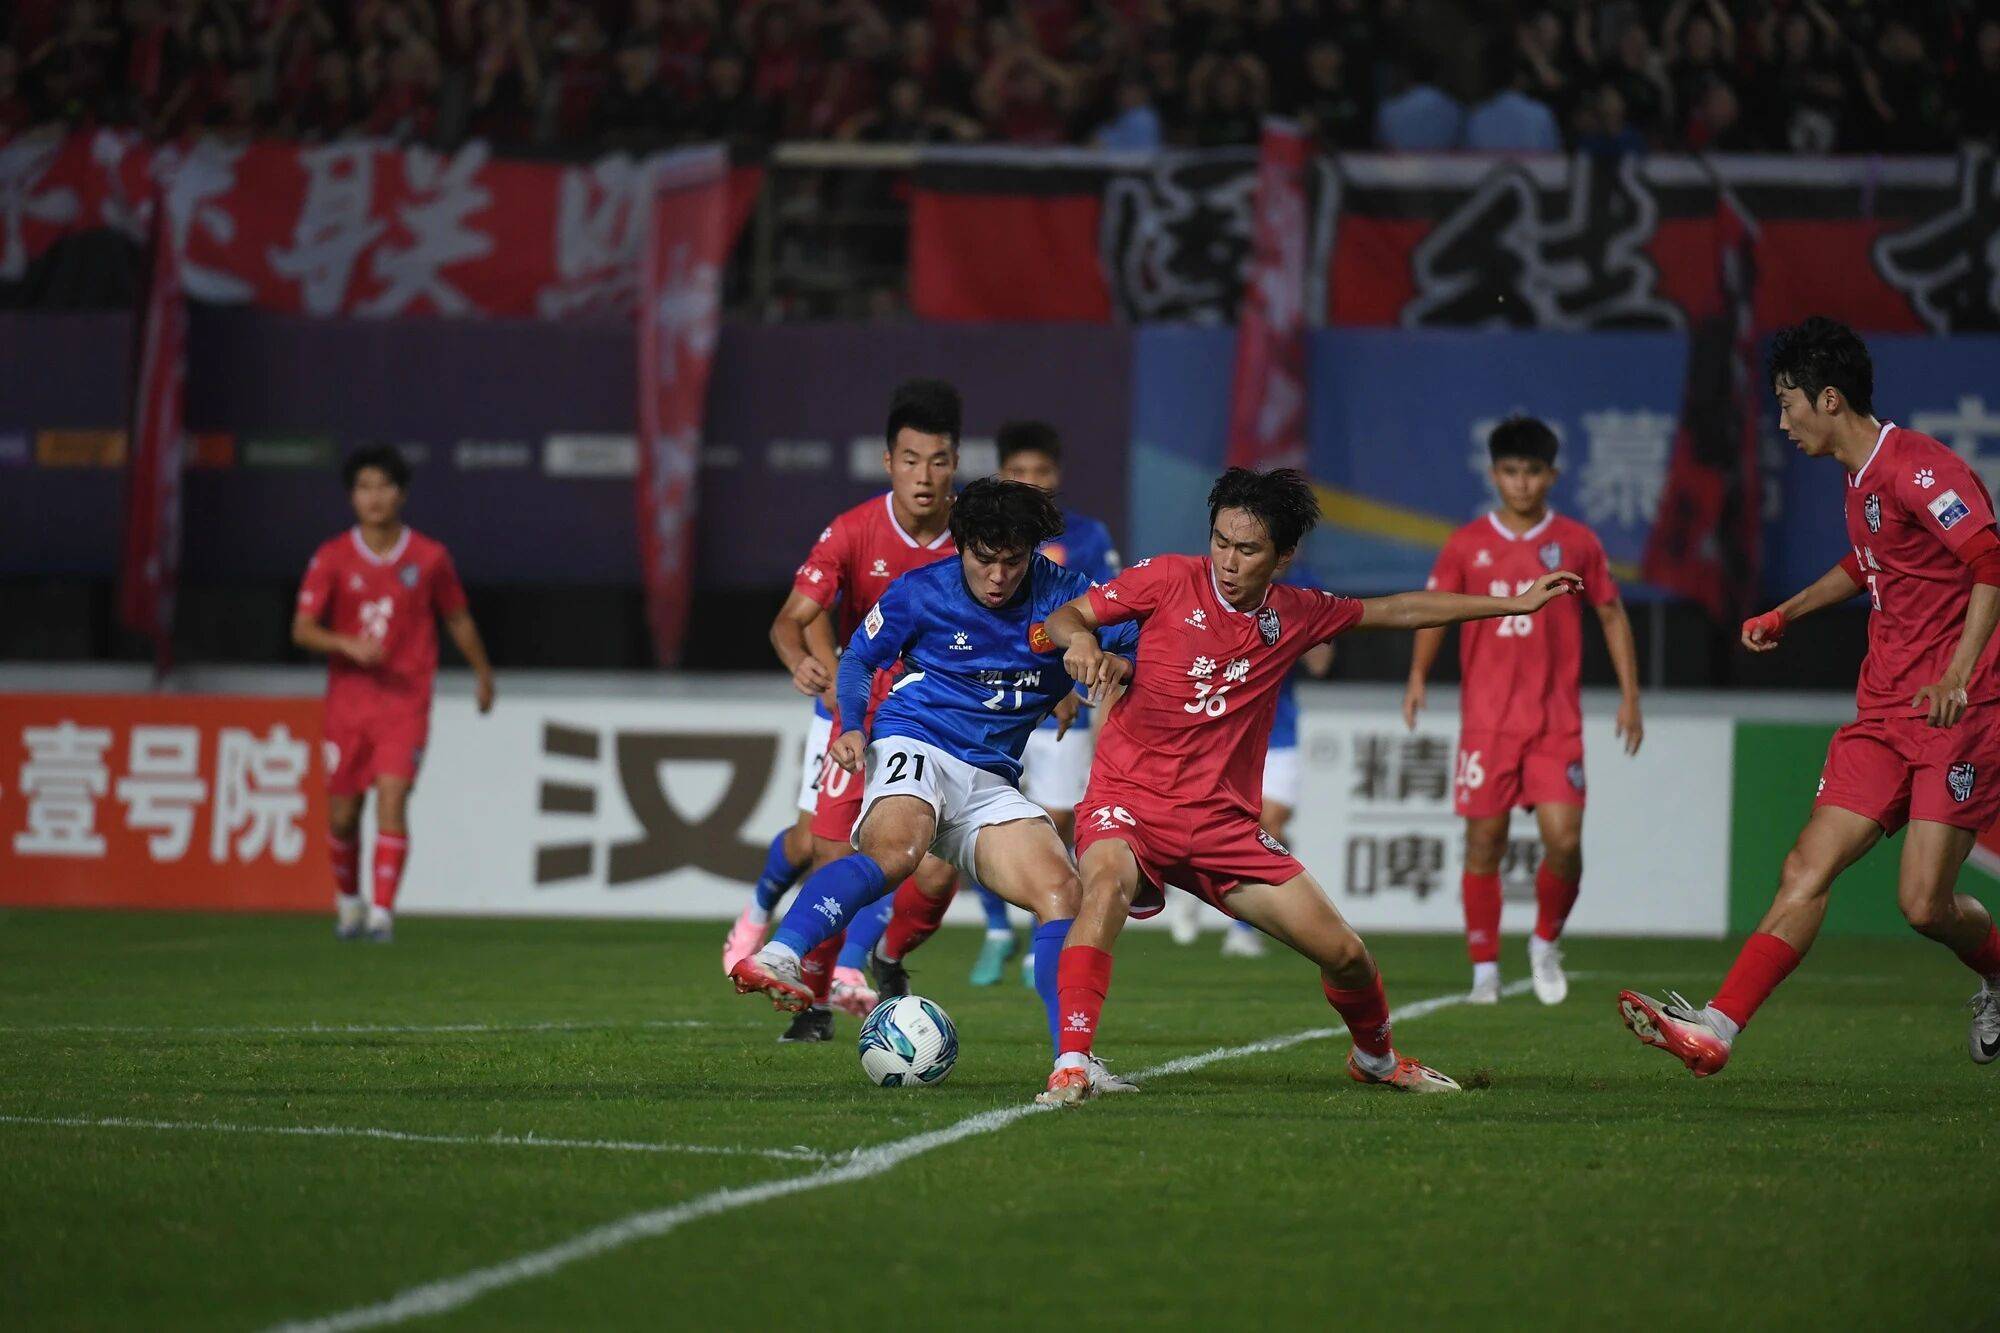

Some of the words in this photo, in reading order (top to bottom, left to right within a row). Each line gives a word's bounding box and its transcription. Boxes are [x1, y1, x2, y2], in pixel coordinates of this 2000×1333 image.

[1184, 617, 1207, 631] KELME
[1187, 655, 1251, 683] 盐城
[982, 686, 1023, 711] 21
[1183, 682, 1231, 718] 36
[884, 751, 926, 785] 21
[12, 718, 311, 864] 壹号院
[1089, 805, 1137, 829] 36
